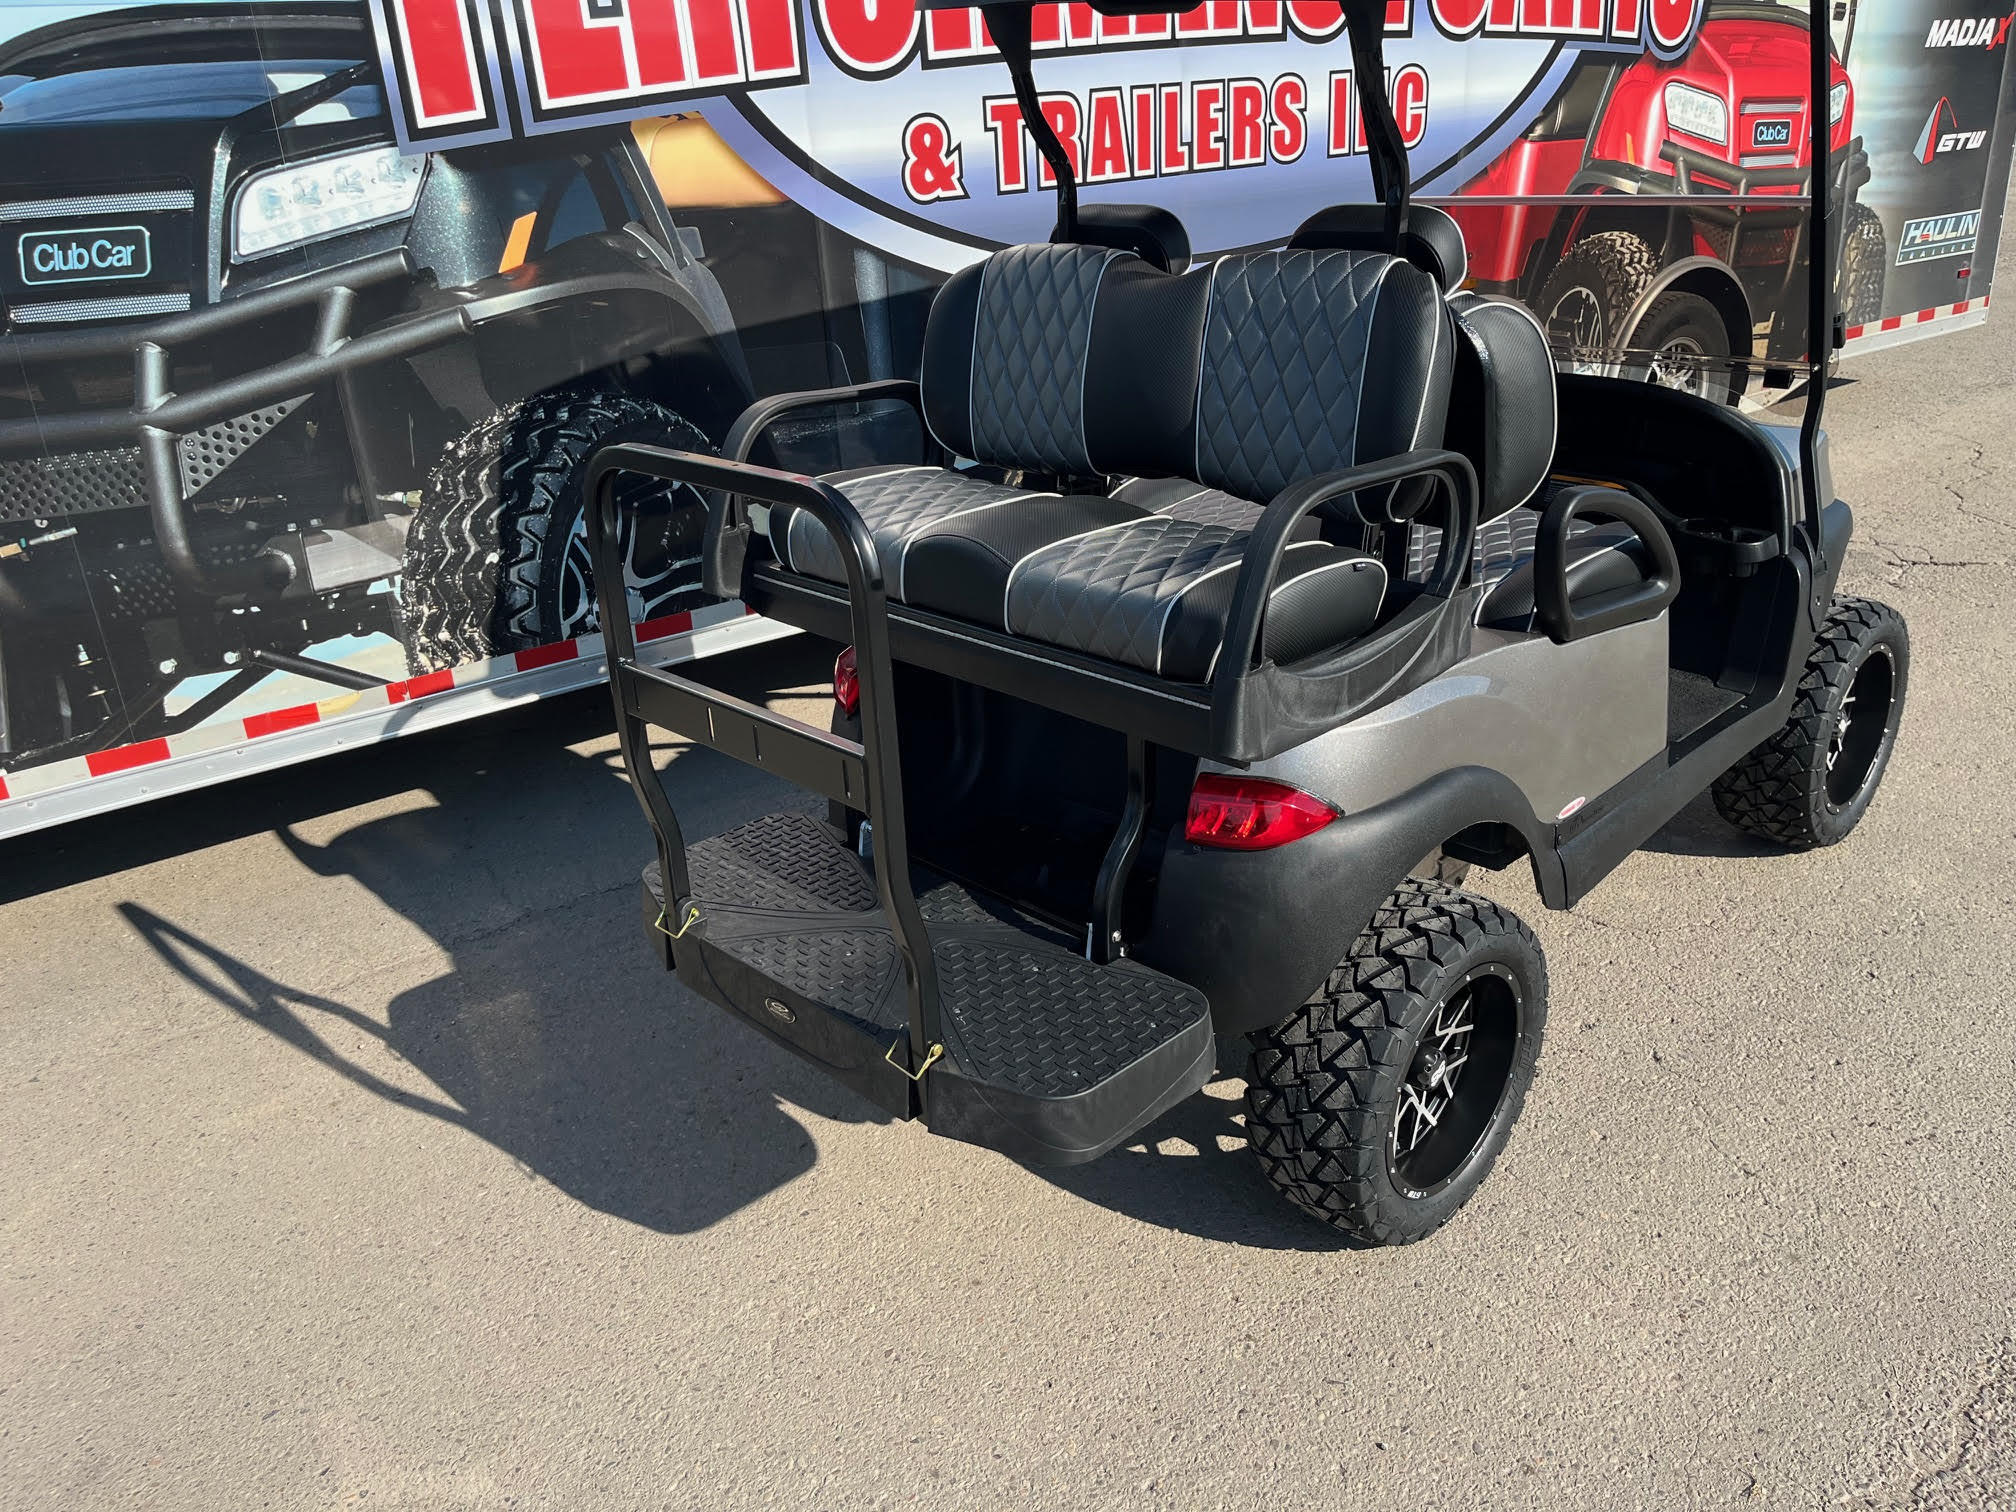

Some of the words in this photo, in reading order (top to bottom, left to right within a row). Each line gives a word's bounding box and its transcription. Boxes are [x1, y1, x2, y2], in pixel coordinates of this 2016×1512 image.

[1924, 11, 2016, 51] MADJAX
[902, 112, 970, 204] &
[984, 74, 1306, 194] TRAILERS
[1757, 125, 1775, 141] Club
[1775, 125, 1788, 140] Car
[1935, 130, 1987, 153] GTW
[1904, 213, 1980, 246] HAULIN
[33, 242, 90, 273] Club
[91, 239, 136, 268] Car
